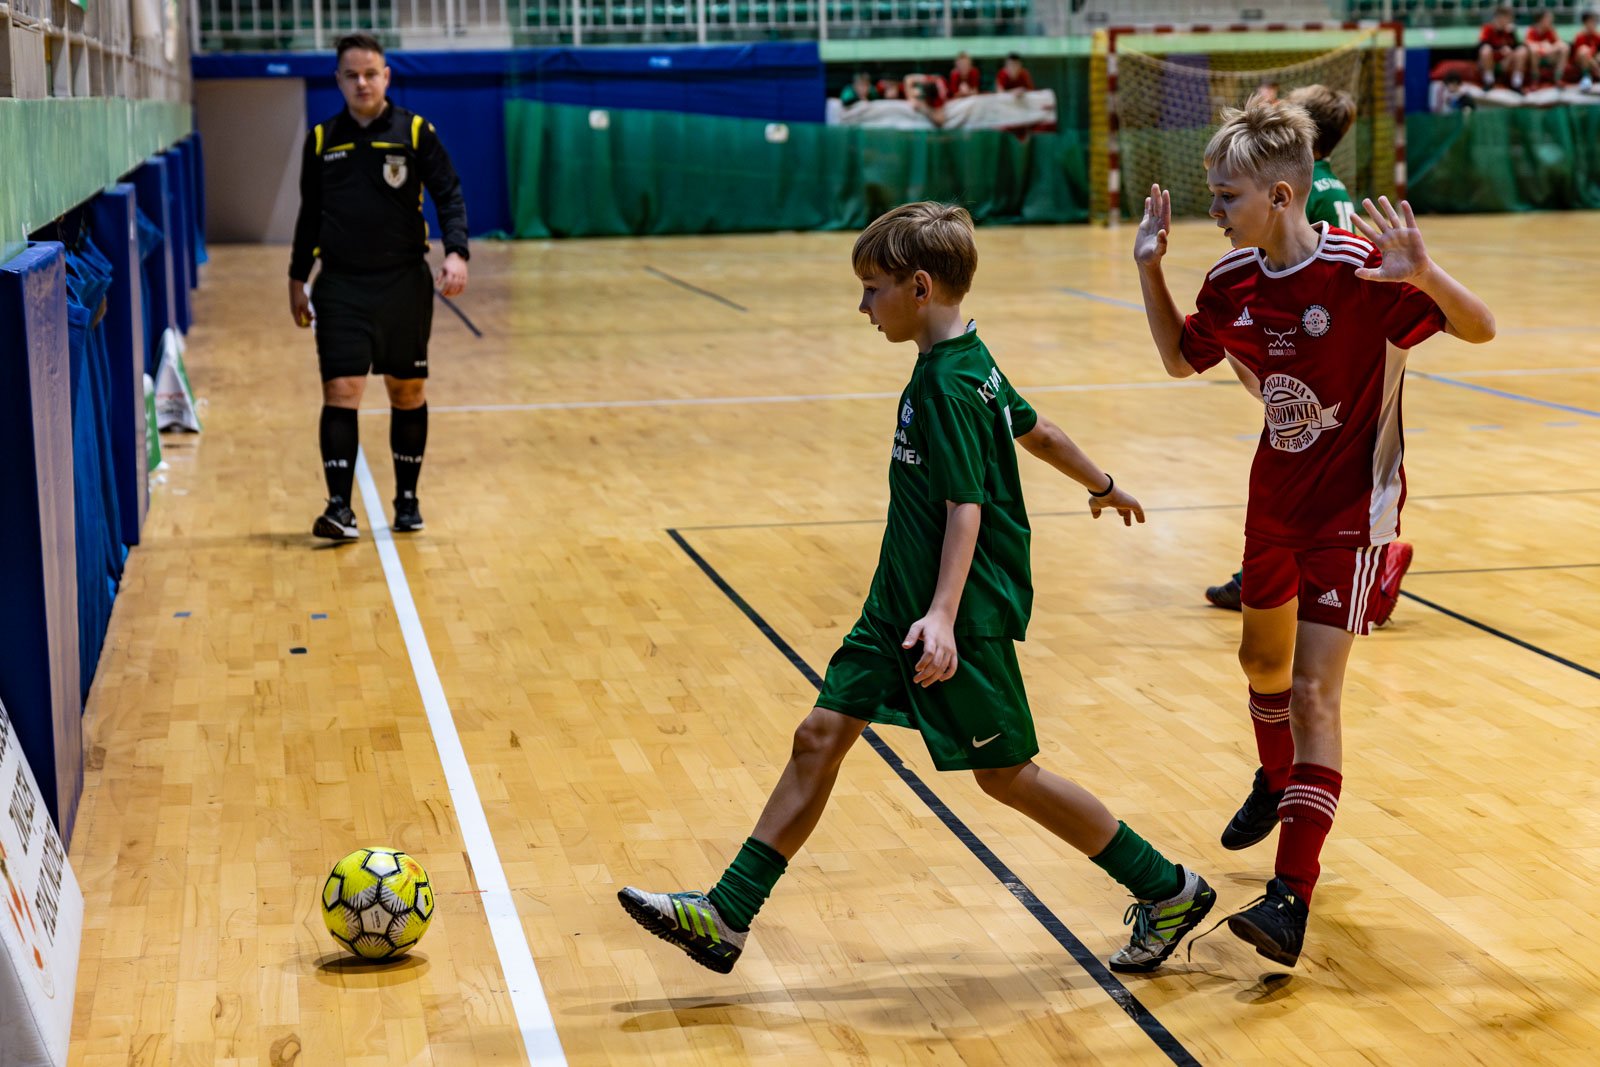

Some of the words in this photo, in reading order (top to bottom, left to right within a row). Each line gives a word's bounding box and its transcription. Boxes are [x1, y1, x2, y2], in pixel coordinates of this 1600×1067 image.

[1233, 319, 1254, 327] adidas
[1266, 376, 1306, 398] PIZZERIA
[1274, 430, 1314, 450] 767-50-50
[1317, 597, 1342, 609] adidas
